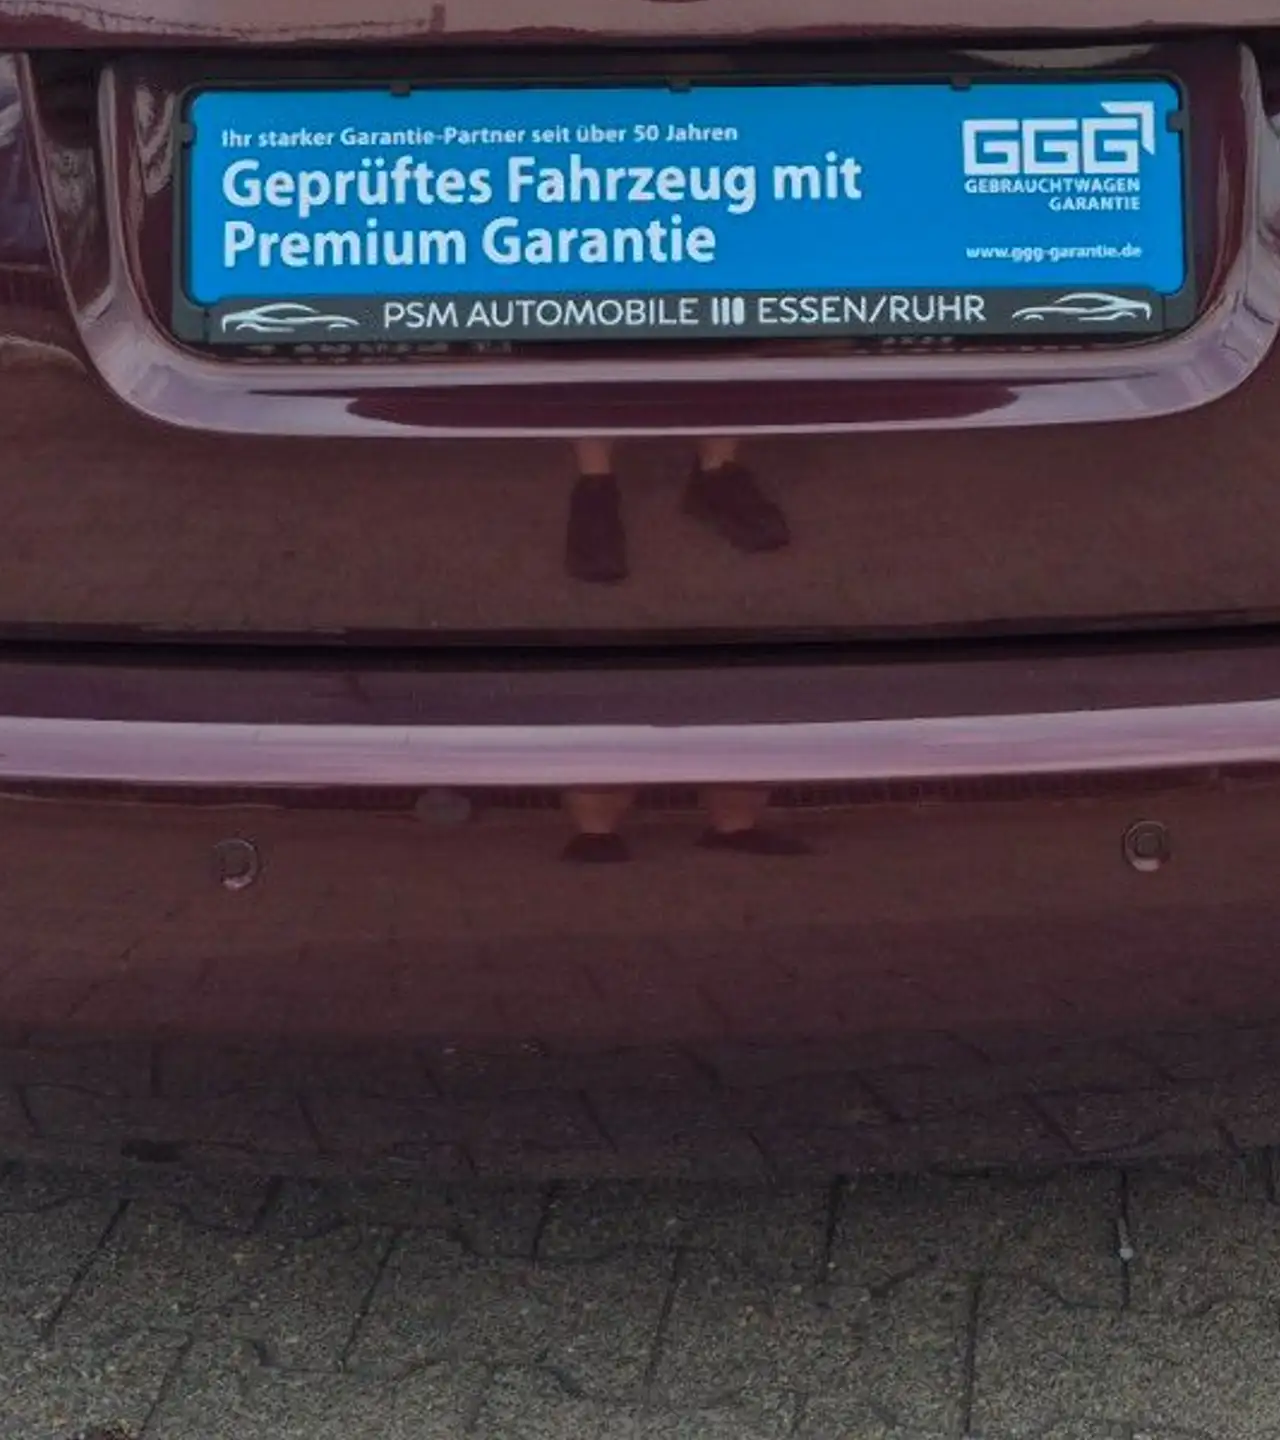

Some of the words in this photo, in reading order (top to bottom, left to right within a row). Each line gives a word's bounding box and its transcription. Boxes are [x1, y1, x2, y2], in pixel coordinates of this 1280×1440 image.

[222, 129, 251, 148] Ihr
[258, 128, 334, 146] starker
[341, 127, 525, 145] Garantie-Partner
[532, 127, 570, 143] seit
[576, 125, 625, 143] über
[634, 125, 659, 142] 50
[666, 124, 738, 142] Jahren
[962, 118, 1139, 175] GGG
[223, 157, 491, 219] Geprüftes
[509, 155, 756, 214] Fahrzeug
[774, 152, 862, 199] mit
[965, 177, 1141, 194] GEBRAUCHTWAGEN
[1049, 196, 1141, 211] GARANTIE
[224, 219, 465, 268] Premium
[482, 214, 716, 264] Garantie
[966, 243, 1142, 262] www.ggg-garantie.de
[384, 301, 460, 329] PSM
[466, 298, 699, 328] AUTOMOBILE
[758, 295, 986, 324] ESSEN/RUHR
